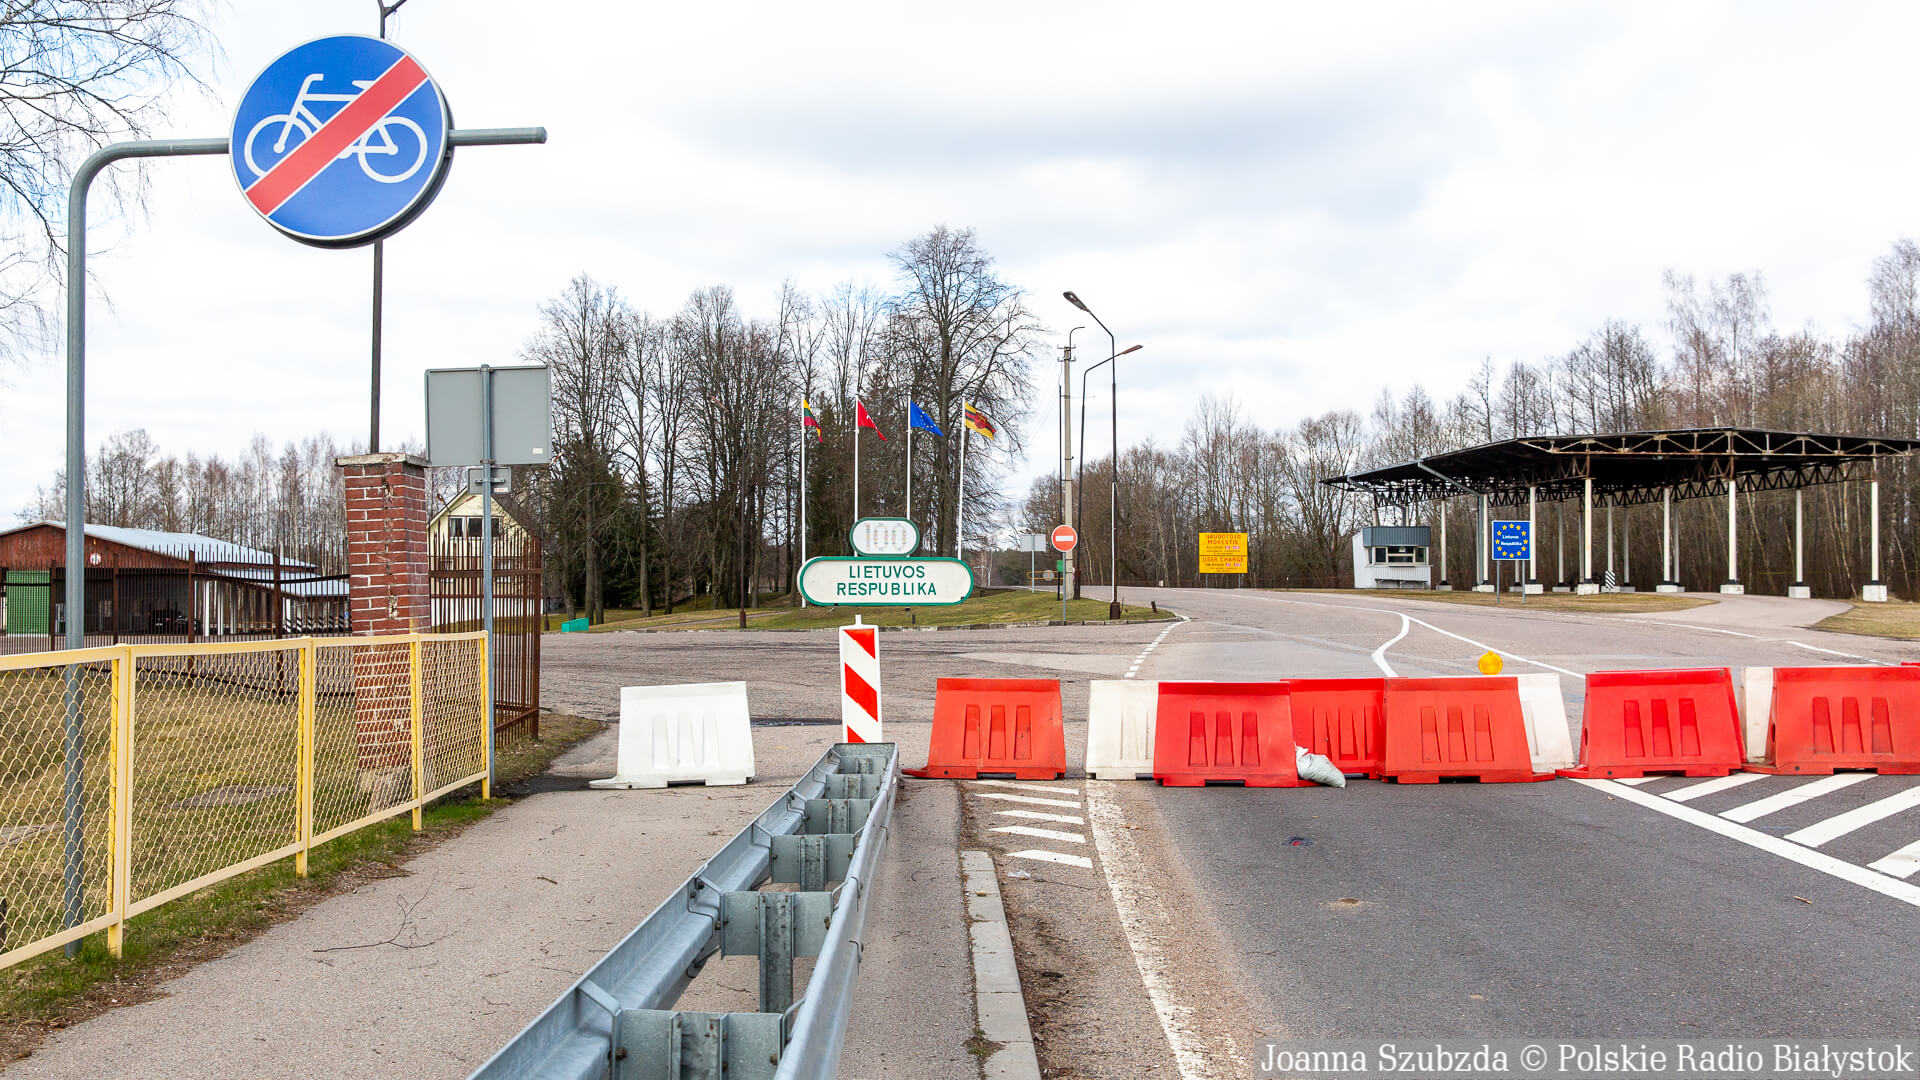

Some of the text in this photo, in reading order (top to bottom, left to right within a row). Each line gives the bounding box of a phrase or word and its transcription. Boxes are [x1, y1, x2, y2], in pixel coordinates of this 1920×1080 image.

[866, 523, 906, 551] 100
[849, 565, 925, 579] LIETUVOS
[836, 582, 937, 596] RESPUBLIKA
